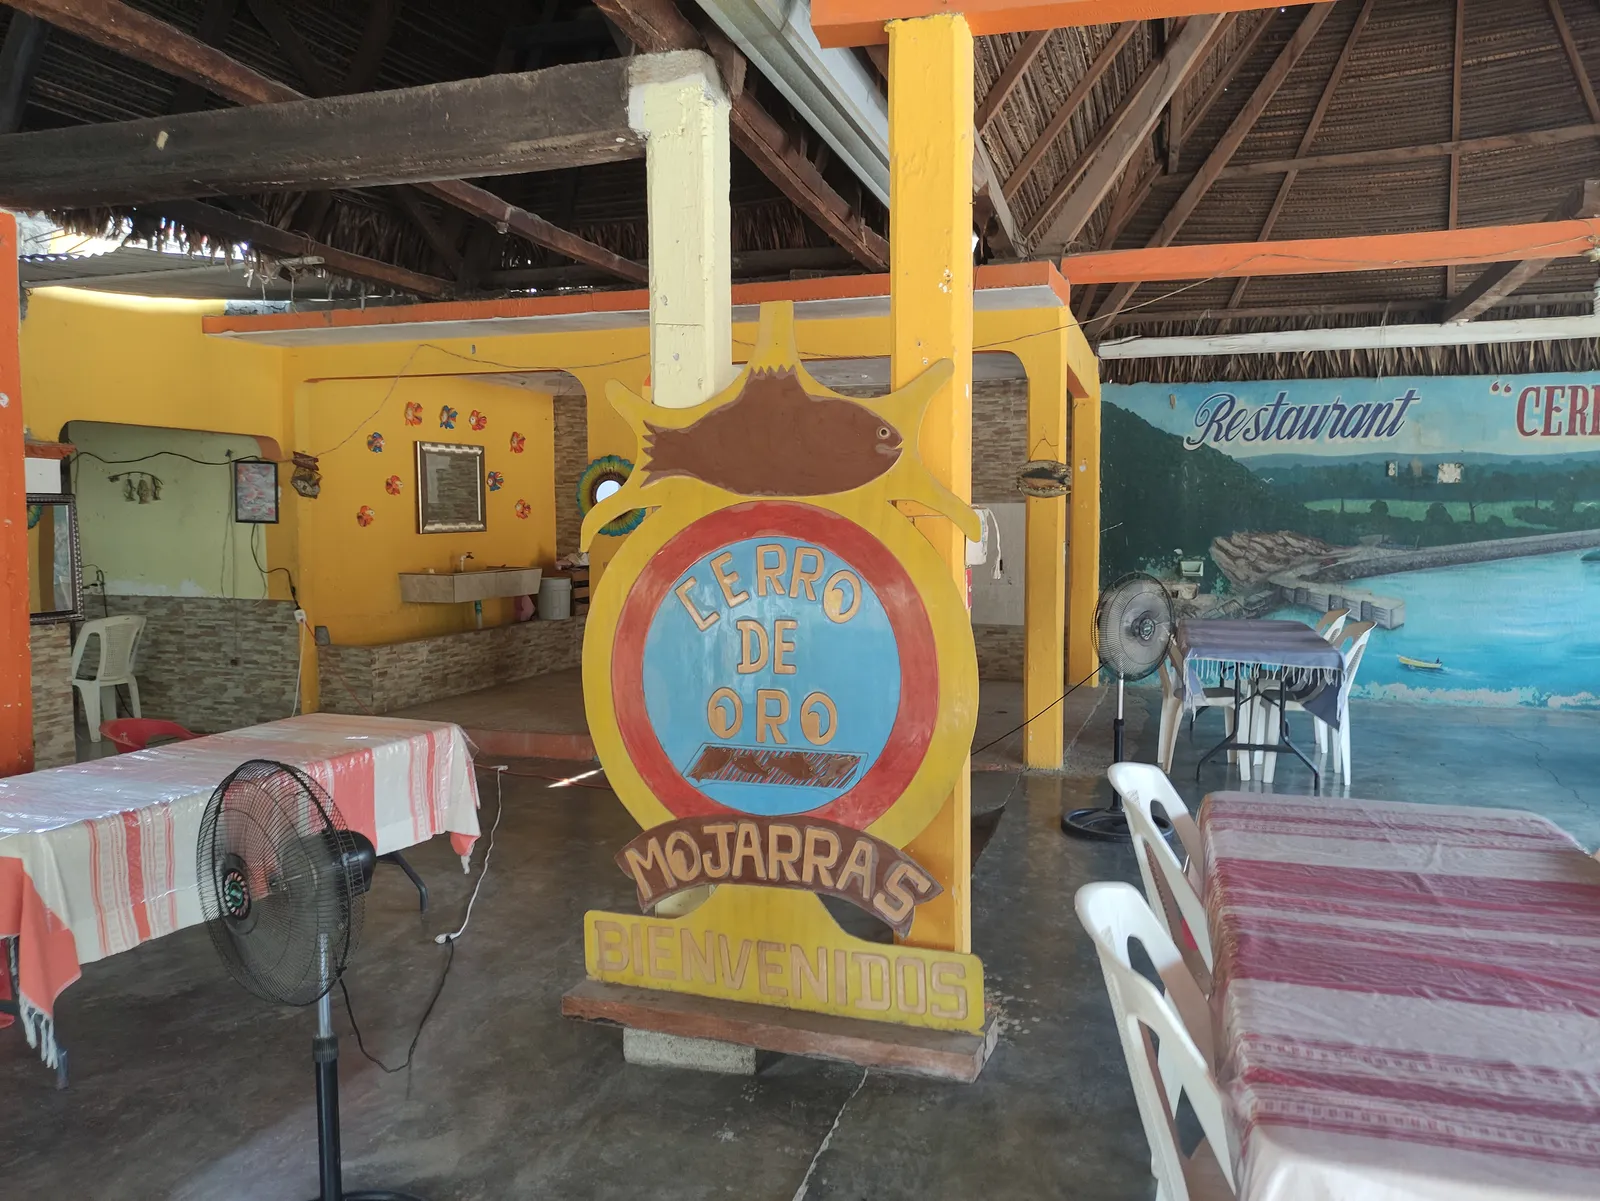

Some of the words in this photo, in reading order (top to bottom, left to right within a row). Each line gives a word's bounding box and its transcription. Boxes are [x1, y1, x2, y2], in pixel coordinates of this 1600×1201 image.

[1185, 388, 1420, 445] Restaurant
[675, 543, 862, 631] CERRO
[736, 618, 797, 675] DE
[706, 686, 838, 745] ORO
[624, 822, 933, 922] MOJARRAS
[593, 919, 968, 1020] BIENVENIDOS
